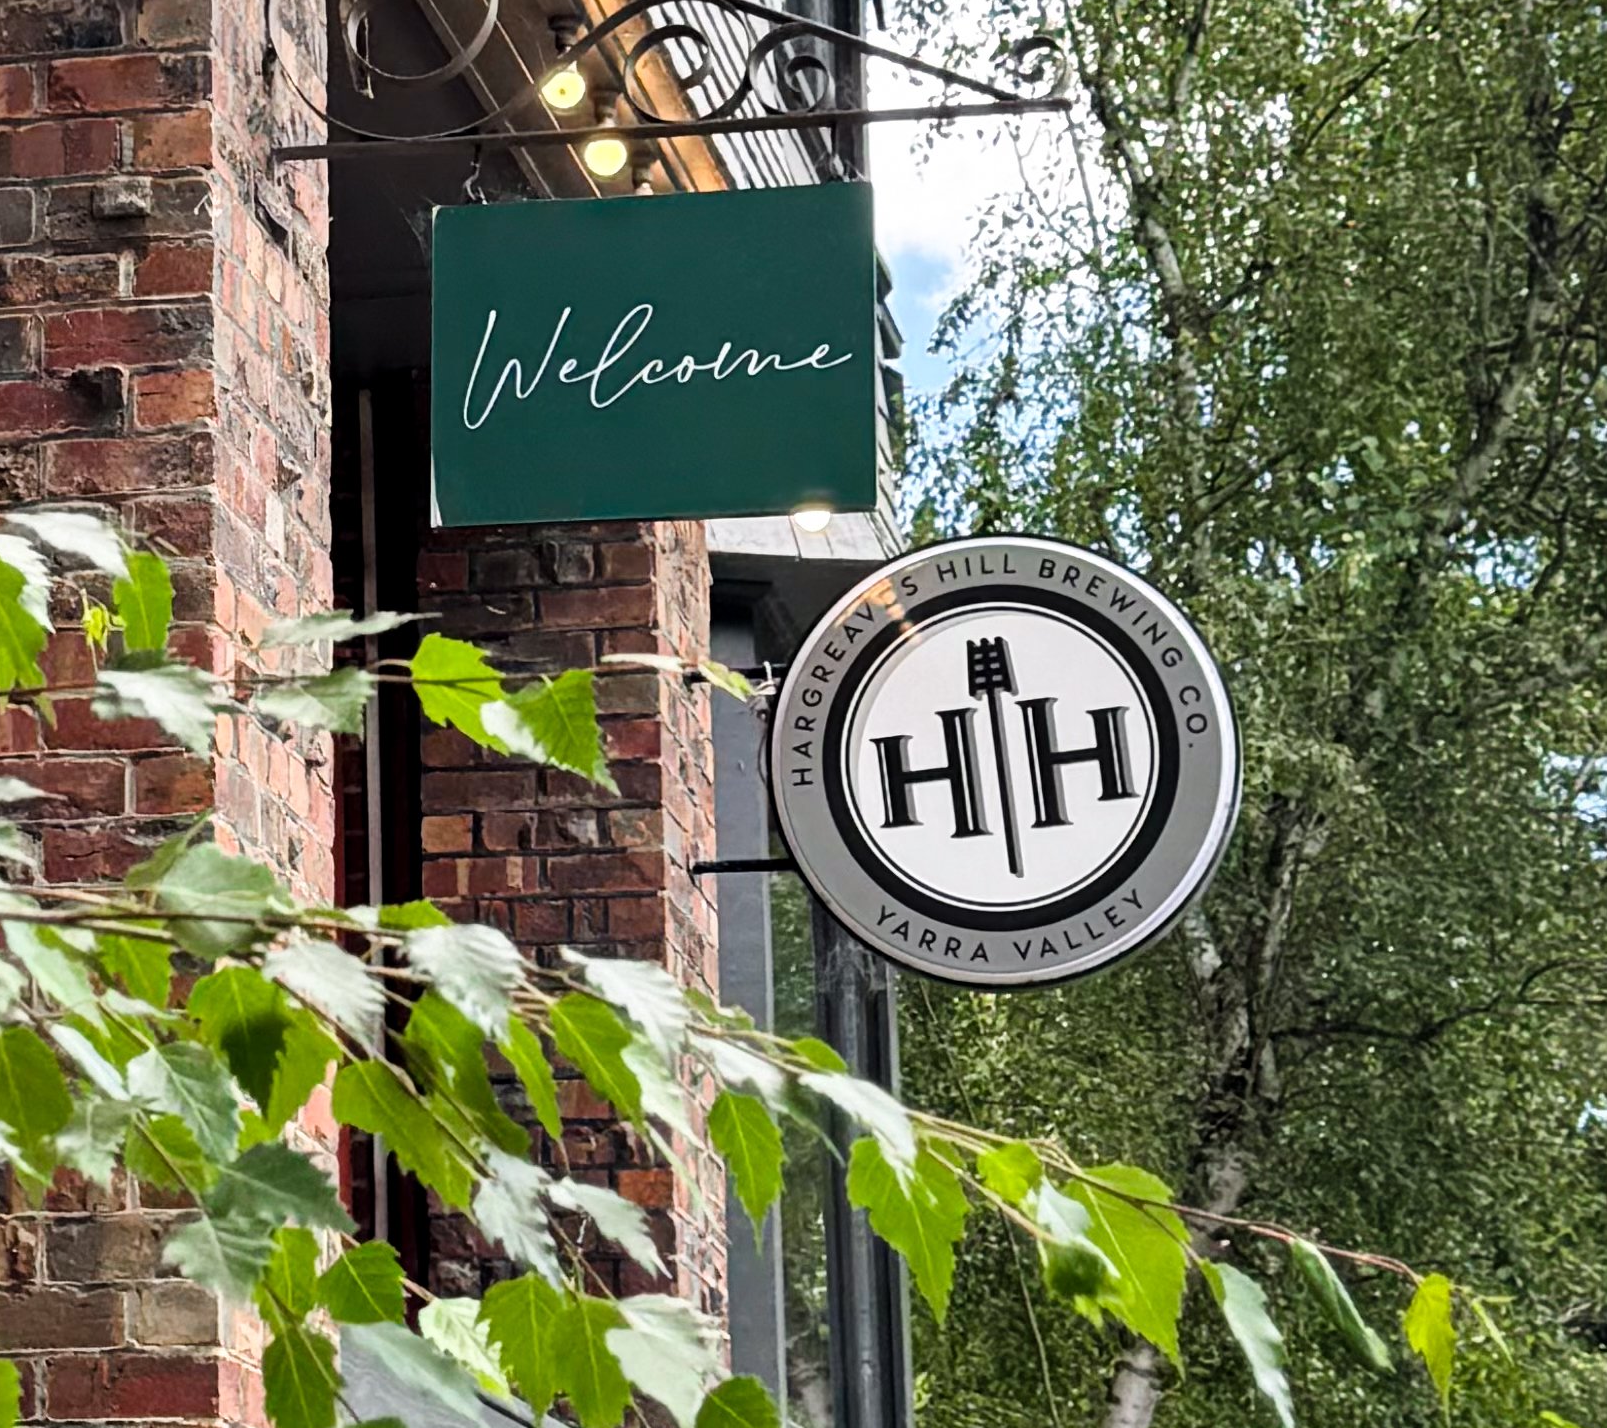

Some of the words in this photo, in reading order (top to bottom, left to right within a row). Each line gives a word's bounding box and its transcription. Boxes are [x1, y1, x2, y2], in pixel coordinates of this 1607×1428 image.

[463, 302, 853, 430] Welcome
[791, 574, 920, 787] HARGREAVS
[935, 552, 1017, 583] HILL
[1038, 558, 1184, 668] BREWING
[1178, 684, 1208, 749] CO.
[875, 904, 990, 963] YARRA
[1012, 888, 1144, 961] VALLEY
